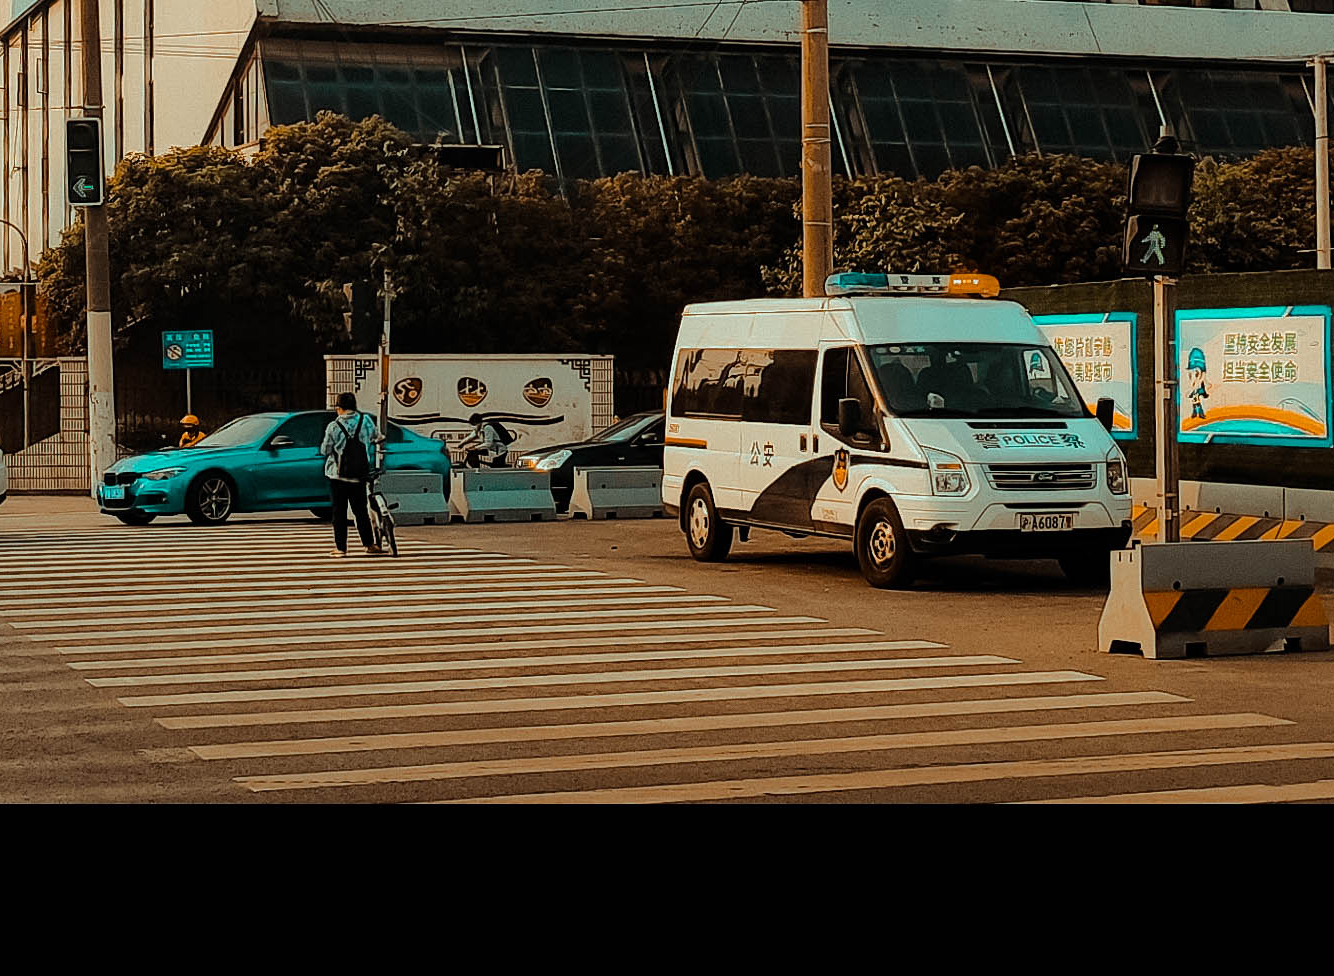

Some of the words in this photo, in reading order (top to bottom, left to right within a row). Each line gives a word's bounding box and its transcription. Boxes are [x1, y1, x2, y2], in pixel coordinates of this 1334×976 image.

[1223, 333, 1298, 355] 坚持安全发展
[1222, 360, 1299, 383] 担当安全使命
[1002, 434, 1060, 446] POLICE
[750, 440, 774, 468] 公安
